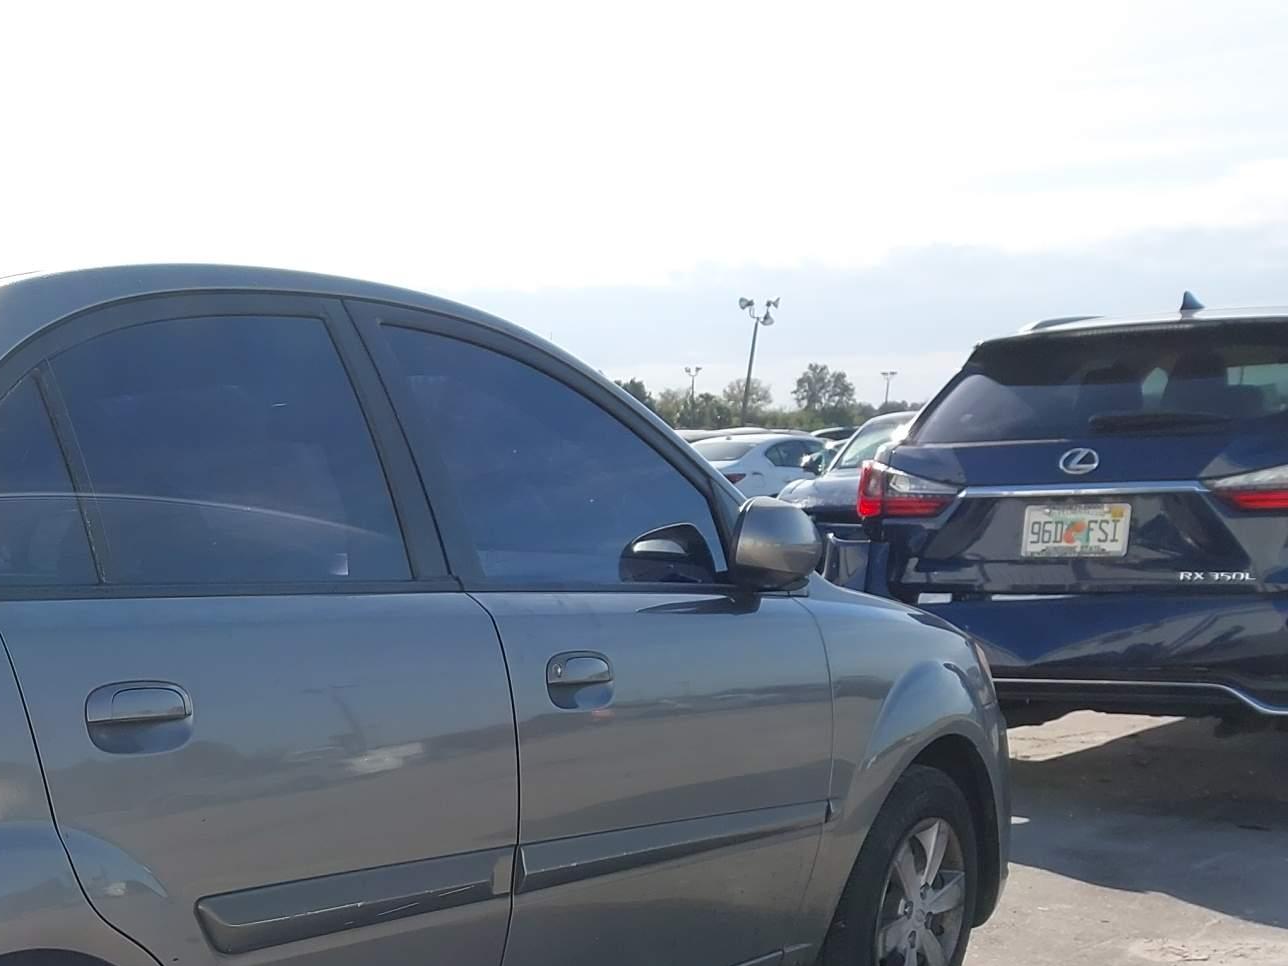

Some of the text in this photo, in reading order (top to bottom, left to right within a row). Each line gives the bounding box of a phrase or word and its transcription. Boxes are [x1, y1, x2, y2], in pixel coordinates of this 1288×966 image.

[1029, 519, 1120, 544] 96D FSI
[1179, 571, 1205, 581] RX
